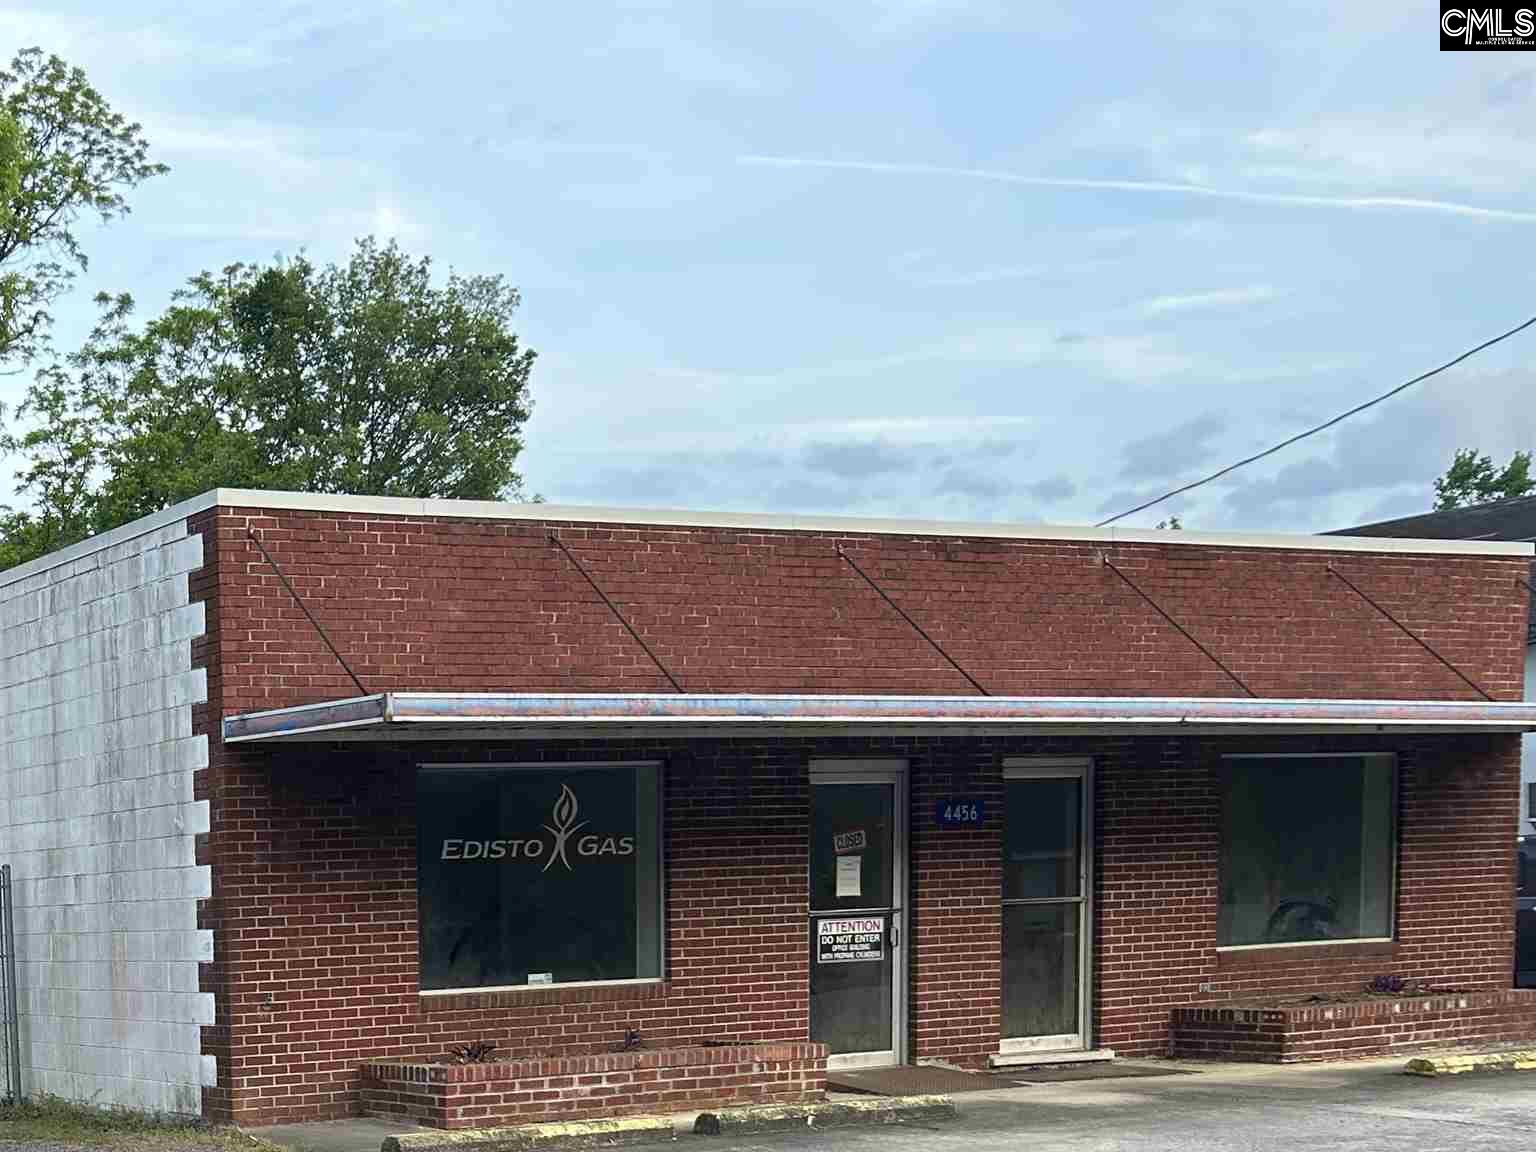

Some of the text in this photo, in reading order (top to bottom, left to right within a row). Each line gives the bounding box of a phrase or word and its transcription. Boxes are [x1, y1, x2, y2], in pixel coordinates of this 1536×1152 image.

[944, 804, 977, 821] 4456
[440, 835, 634, 860] EDISTO GAS
[821, 920, 881, 933] ATTENTION
[821, 934, 881, 945] DO NOT ENTER
